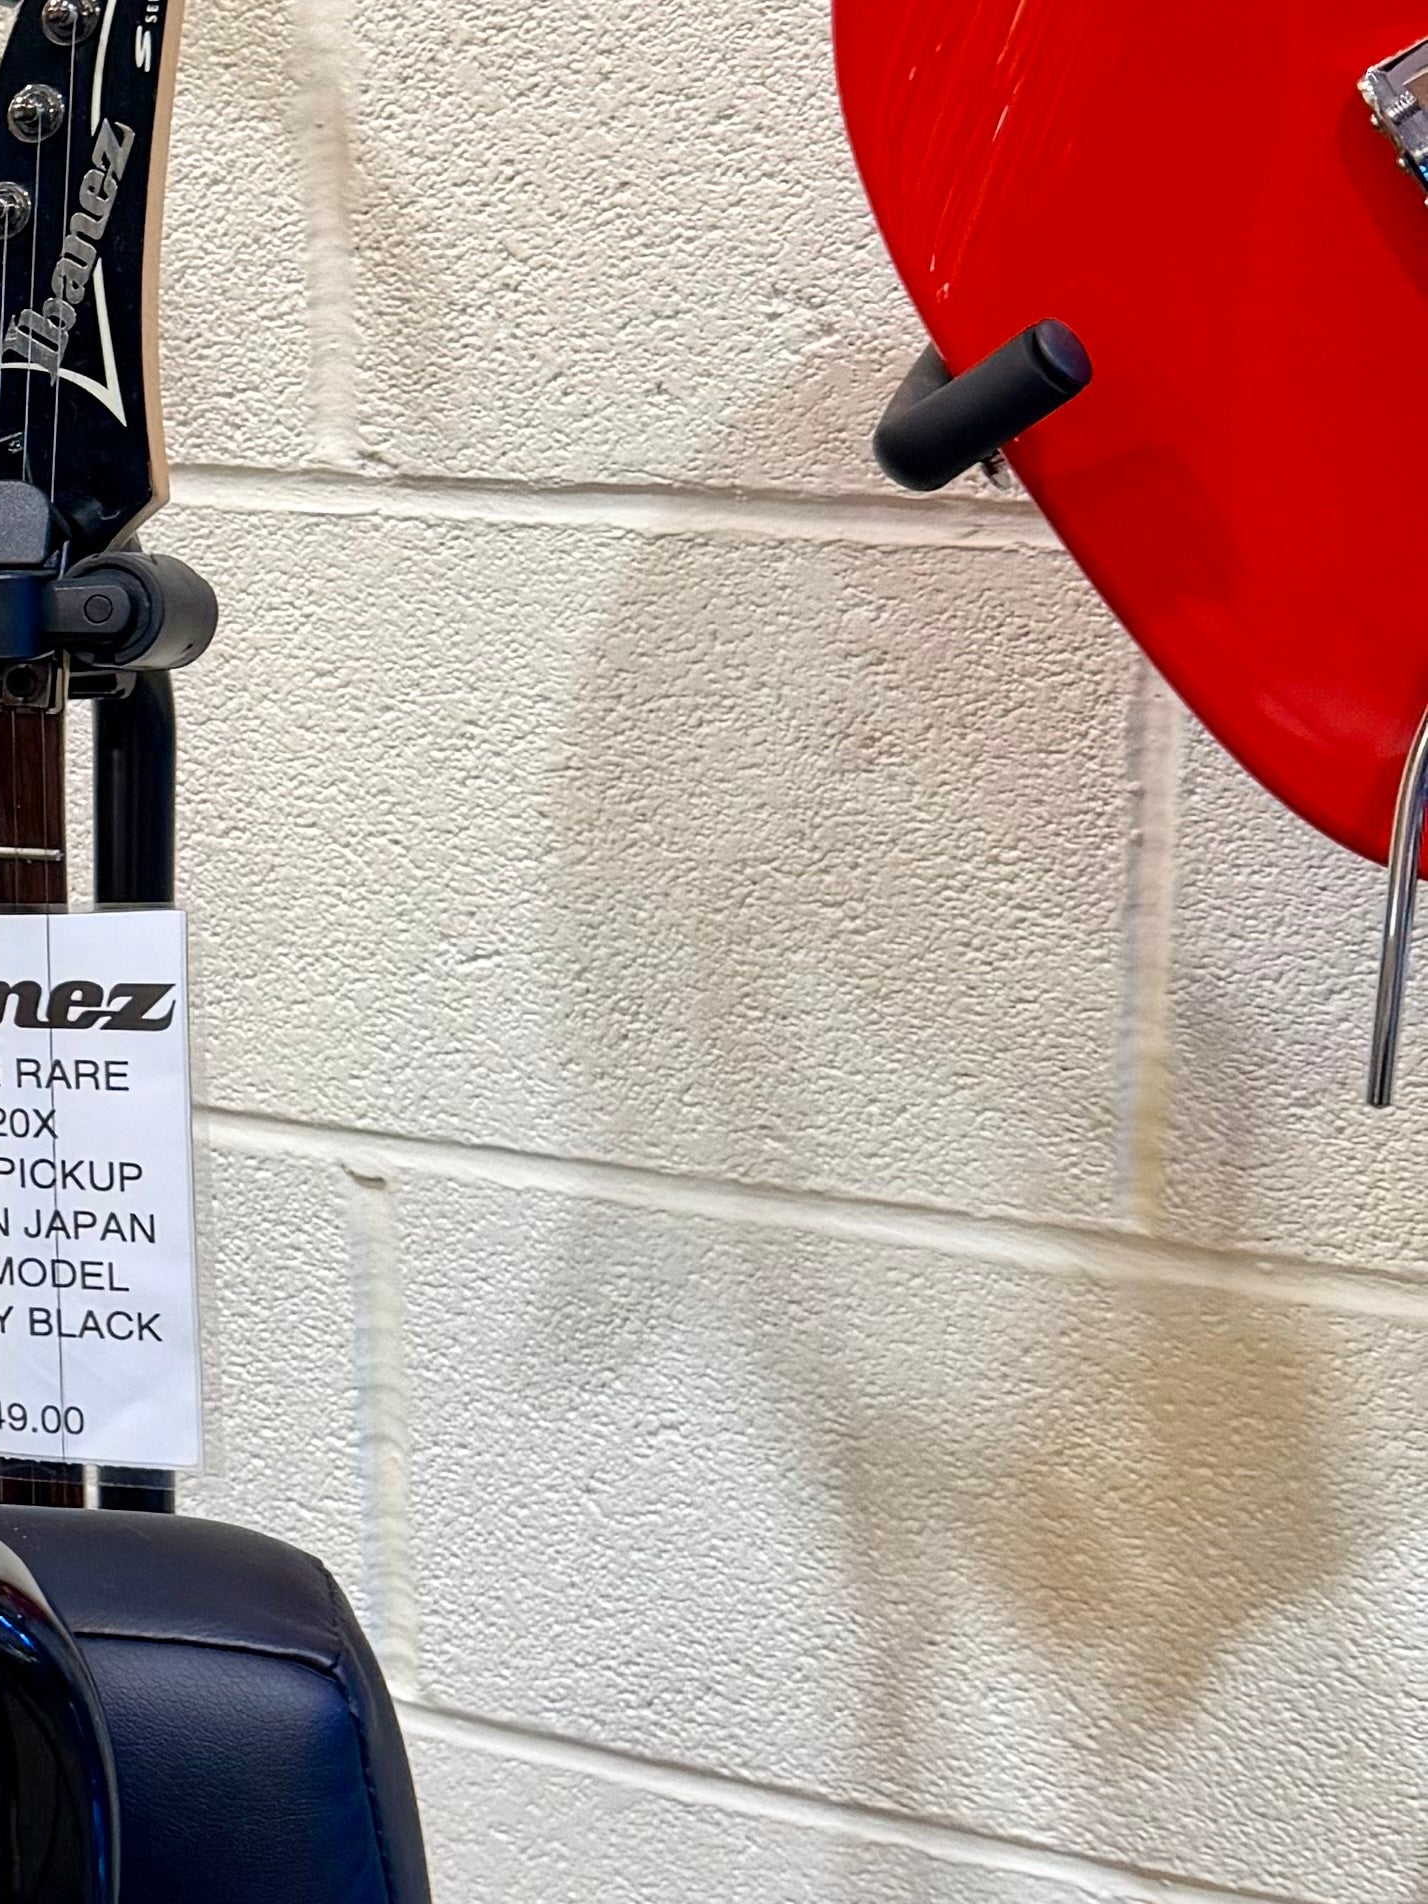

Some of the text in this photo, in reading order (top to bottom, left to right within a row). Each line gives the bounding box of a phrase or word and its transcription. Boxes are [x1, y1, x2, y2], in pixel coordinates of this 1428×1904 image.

[2, 117, 136, 389] Ibanez
[15, 1057, 130, 1093] RARE
[23, 1207, 157, 1245] JAPAN
[28, 1306, 164, 1344] BLACK
